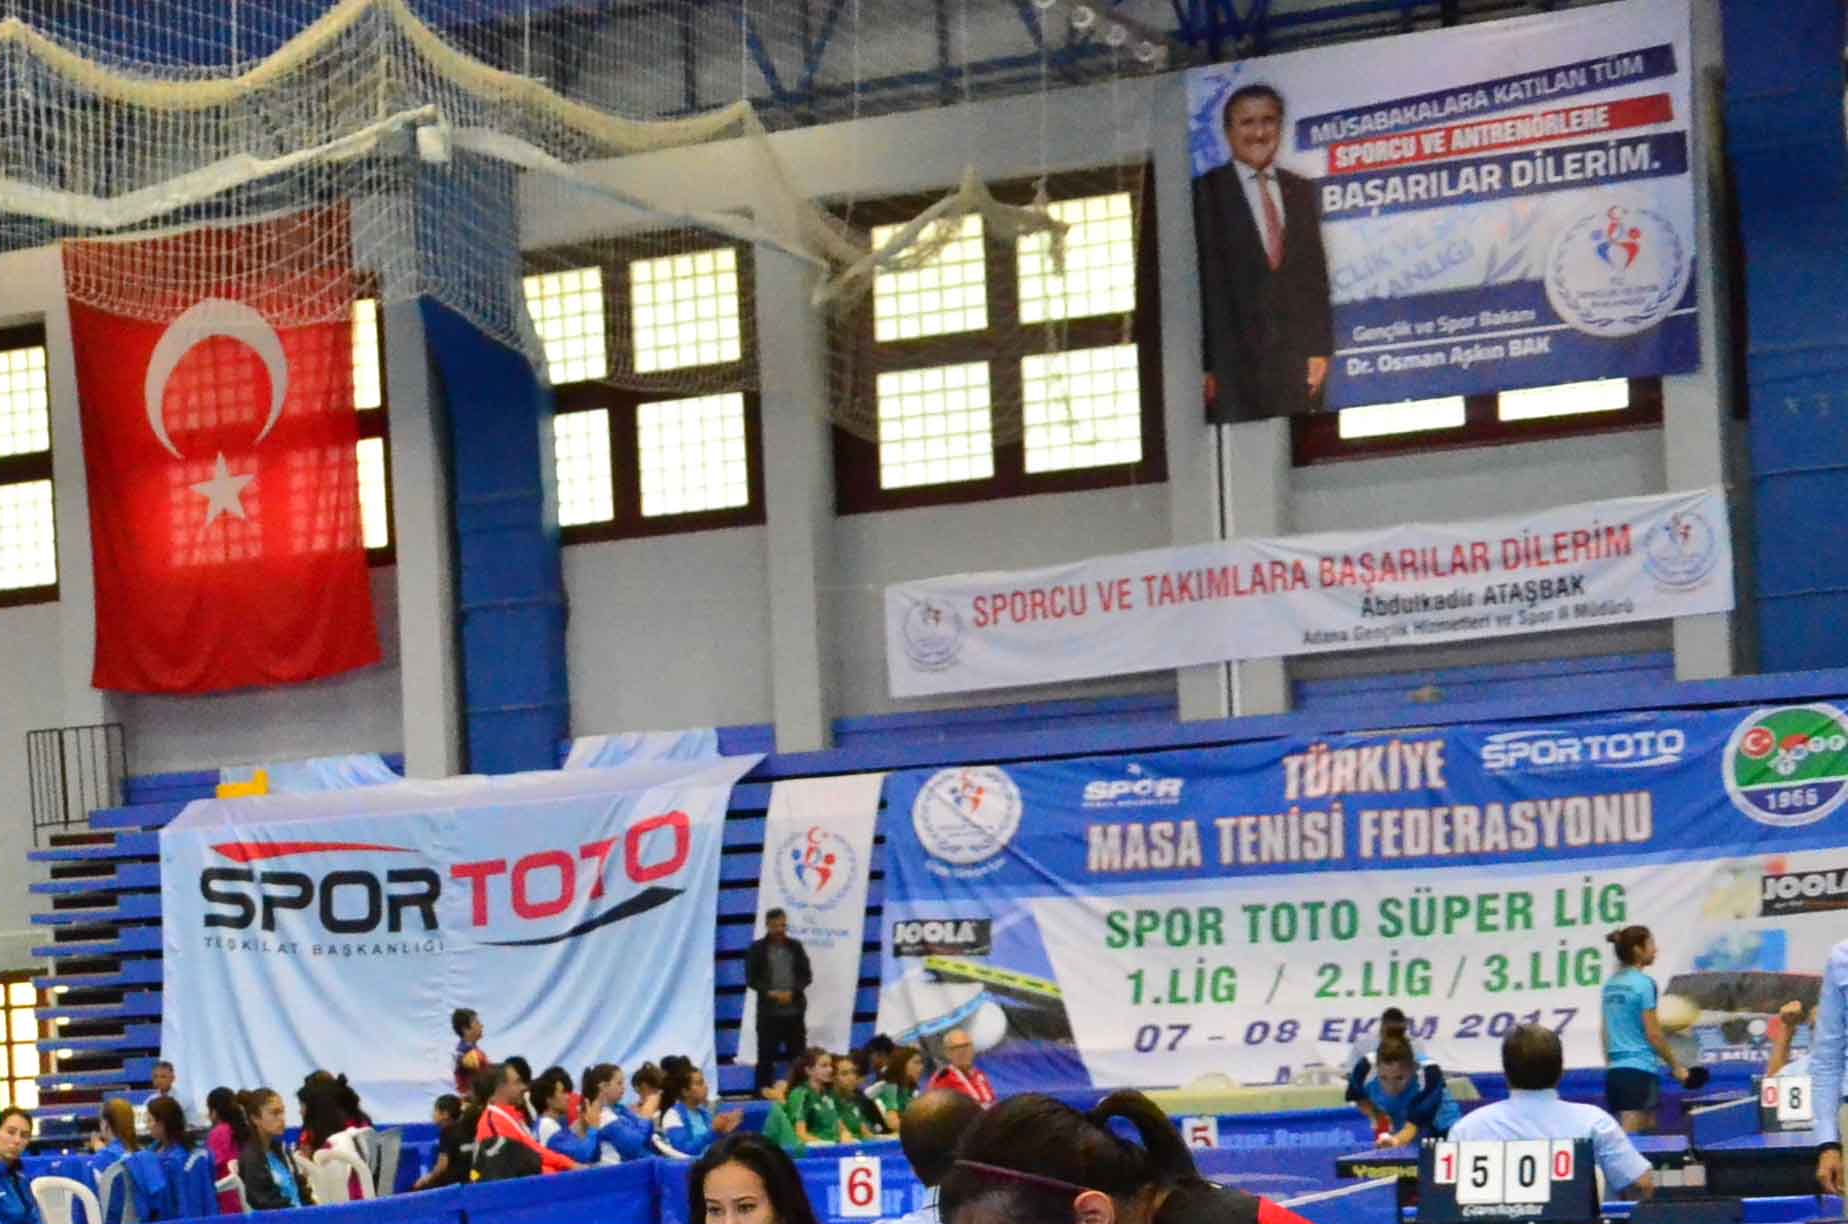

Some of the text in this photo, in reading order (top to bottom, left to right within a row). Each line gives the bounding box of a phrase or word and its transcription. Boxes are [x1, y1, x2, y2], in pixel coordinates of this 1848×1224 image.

[1310, 55, 1644, 145] MÜSABAKALARA KATILAN TÜM
[1320, 140, 1661, 217] BAŞARILAR DİLERİM.
[1346, 357, 1374, 377] Dr.
[1378, 349, 1445, 372] Osman
[1509, 336, 1551, 356] BAK
[972, 520, 1632, 628] SPORCU VE TAKIMLARA BAŞARILAR DİLERİM
[1482, 574, 1584, 609] ATAŞBAK
[1083, 778, 1184, 800] SPOR
[1283, 739, 1446, 799] TÜRKİYE
[1087, 791, 1652, 873] MASA TENİSİ FEDERASYONU
[895, 921, 976, 944] JOOLA
[1106, 876, 1626, 949] SPOR TOTO SÜPER LİG
[203, 936, 445, 957] TEŞKİLAT BAŞKANLIĞI
[1128, 957, 1238, 1006] 1.LİG
[1315, 950, 1433, 999] 2.LİG
[1483, 939, 1602, 992] 3.LİG
[1134, 1022, 1190, 1053] 07
[1243, 1018, 1299, 1046] 08
[1319, 1014, 1438, 1045] EKM
[1764, 1085, 1801, 1109] 0 8
[848, 1167, 874, 1206] 6
[1441, 1150, 1570, 1188] 1 5 0 0
